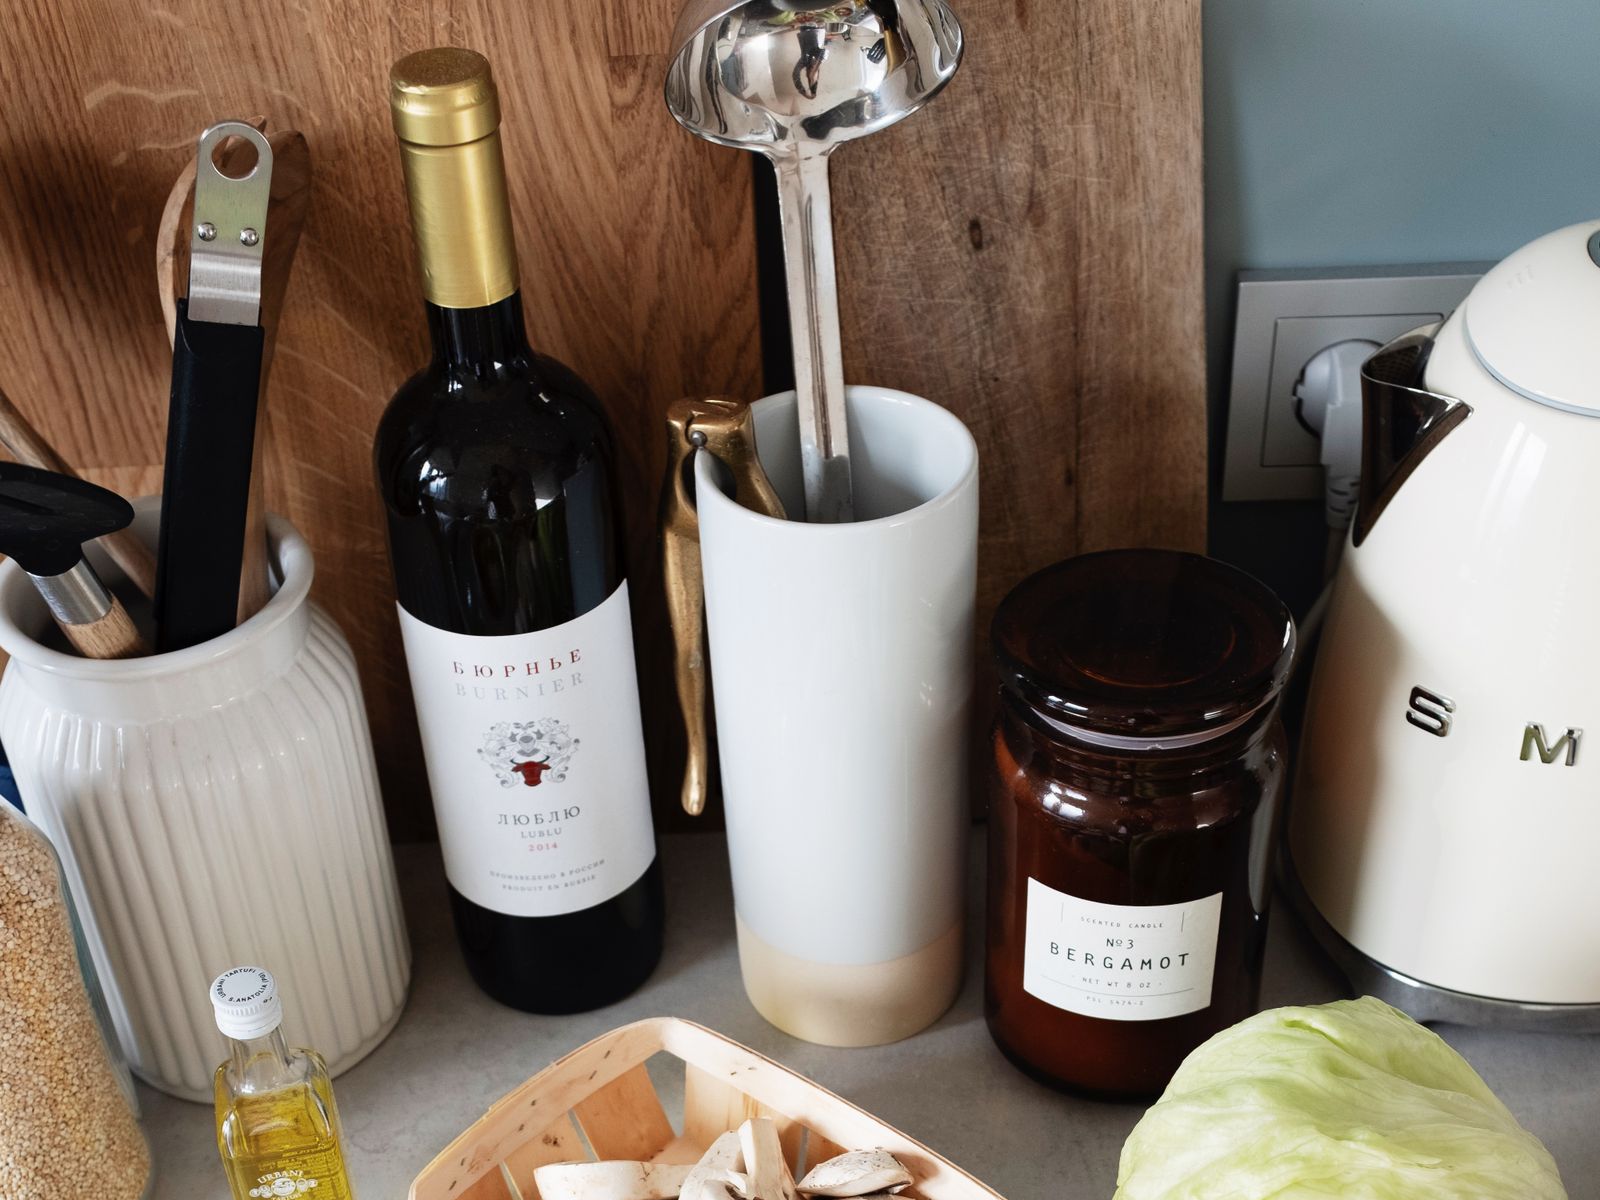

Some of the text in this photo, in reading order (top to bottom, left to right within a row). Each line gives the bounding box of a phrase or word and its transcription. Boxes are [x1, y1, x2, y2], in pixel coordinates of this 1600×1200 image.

[452, 648, 582, 678] БЮРНЬЕ
[455, 672, 584, 701] BURNIER
[497, 805, 581, 826] ЛЮБЛЮ
[520, 827, 563, 840] LUBLU
[528, 842, 559, 853] 2014
[1080, 916, 1121, 928] SCENTED
[1050, 941, 1190, 971] BERGAMOT
[216, 968, 257, 999] URBANI TARTUFI
[1082, 977, 1100, 985] NET
[1139, 981, 1152, 989] OZ
[257, 1169, 304, 1184] URBANI
